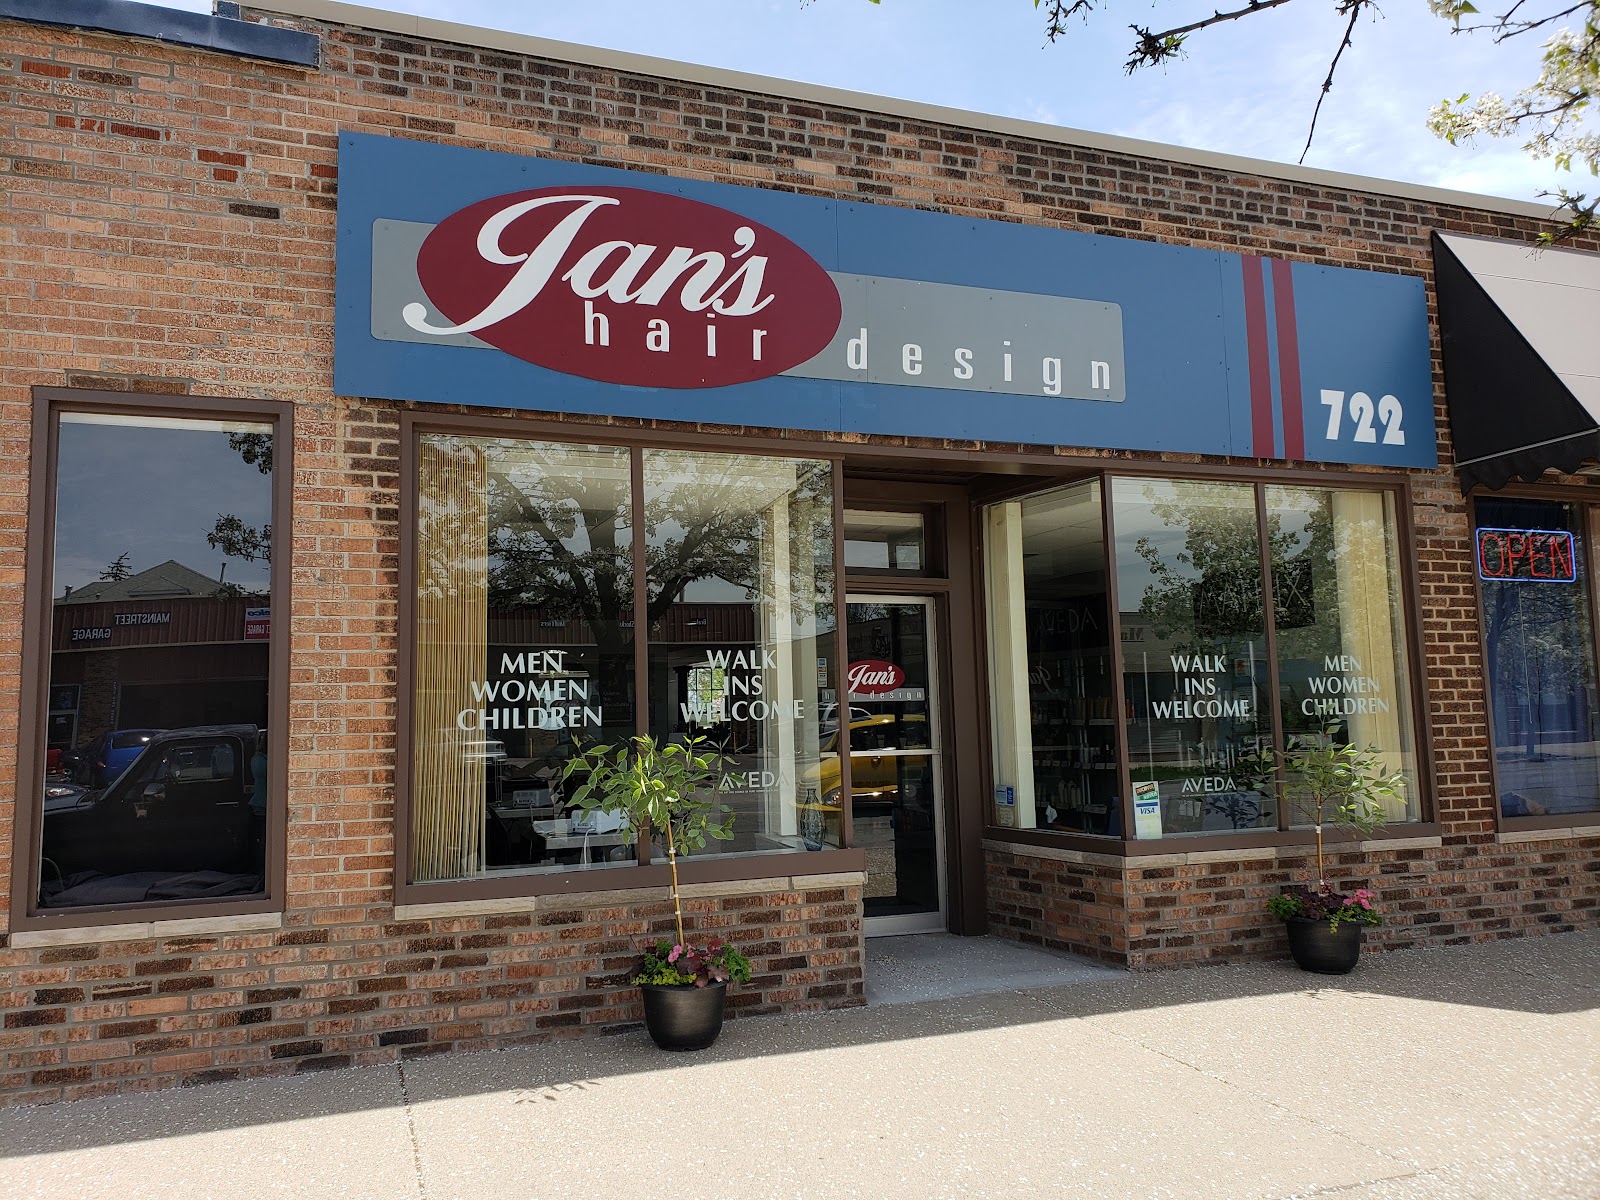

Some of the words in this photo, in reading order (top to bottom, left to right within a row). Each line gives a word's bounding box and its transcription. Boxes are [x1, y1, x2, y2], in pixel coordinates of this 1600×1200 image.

[402, 195, 775, 335] Jan's
[585, 300, 767, 361] hair
[846, 328, 1110, 395] design
[1320, 389, 1406, 446] 722
[1480, 533, 1573, 579] OPEN
[500, 652, 563, 674] MEN
[706, 649, 778, 670] WALK
[1170, 655, 1227, 674] WALK
[1324, 655, 1363, 673] MEN
[723, 675, 764, 696] INS
[847, 663, 897, 693] Jan's
[1184, 677, 1217, 696] INS
[1308, 676, 1381, 695] WOMEN
[471, 679, 588, 703] WOMEN
[870, 690, 922, 702] design
[680, 699, 806, 723] WELCOME
[1152, 699, 1250, 720] WELCOME
[1301, 697, 1391, 717] CHILDREN
[457, 706, 603, 731] CHILDREN
[718, 771, 791, 789] AVEDA
[1181, 776, 1237, 793] AVEDA
[1139, 806, 1156, 815] VISA
